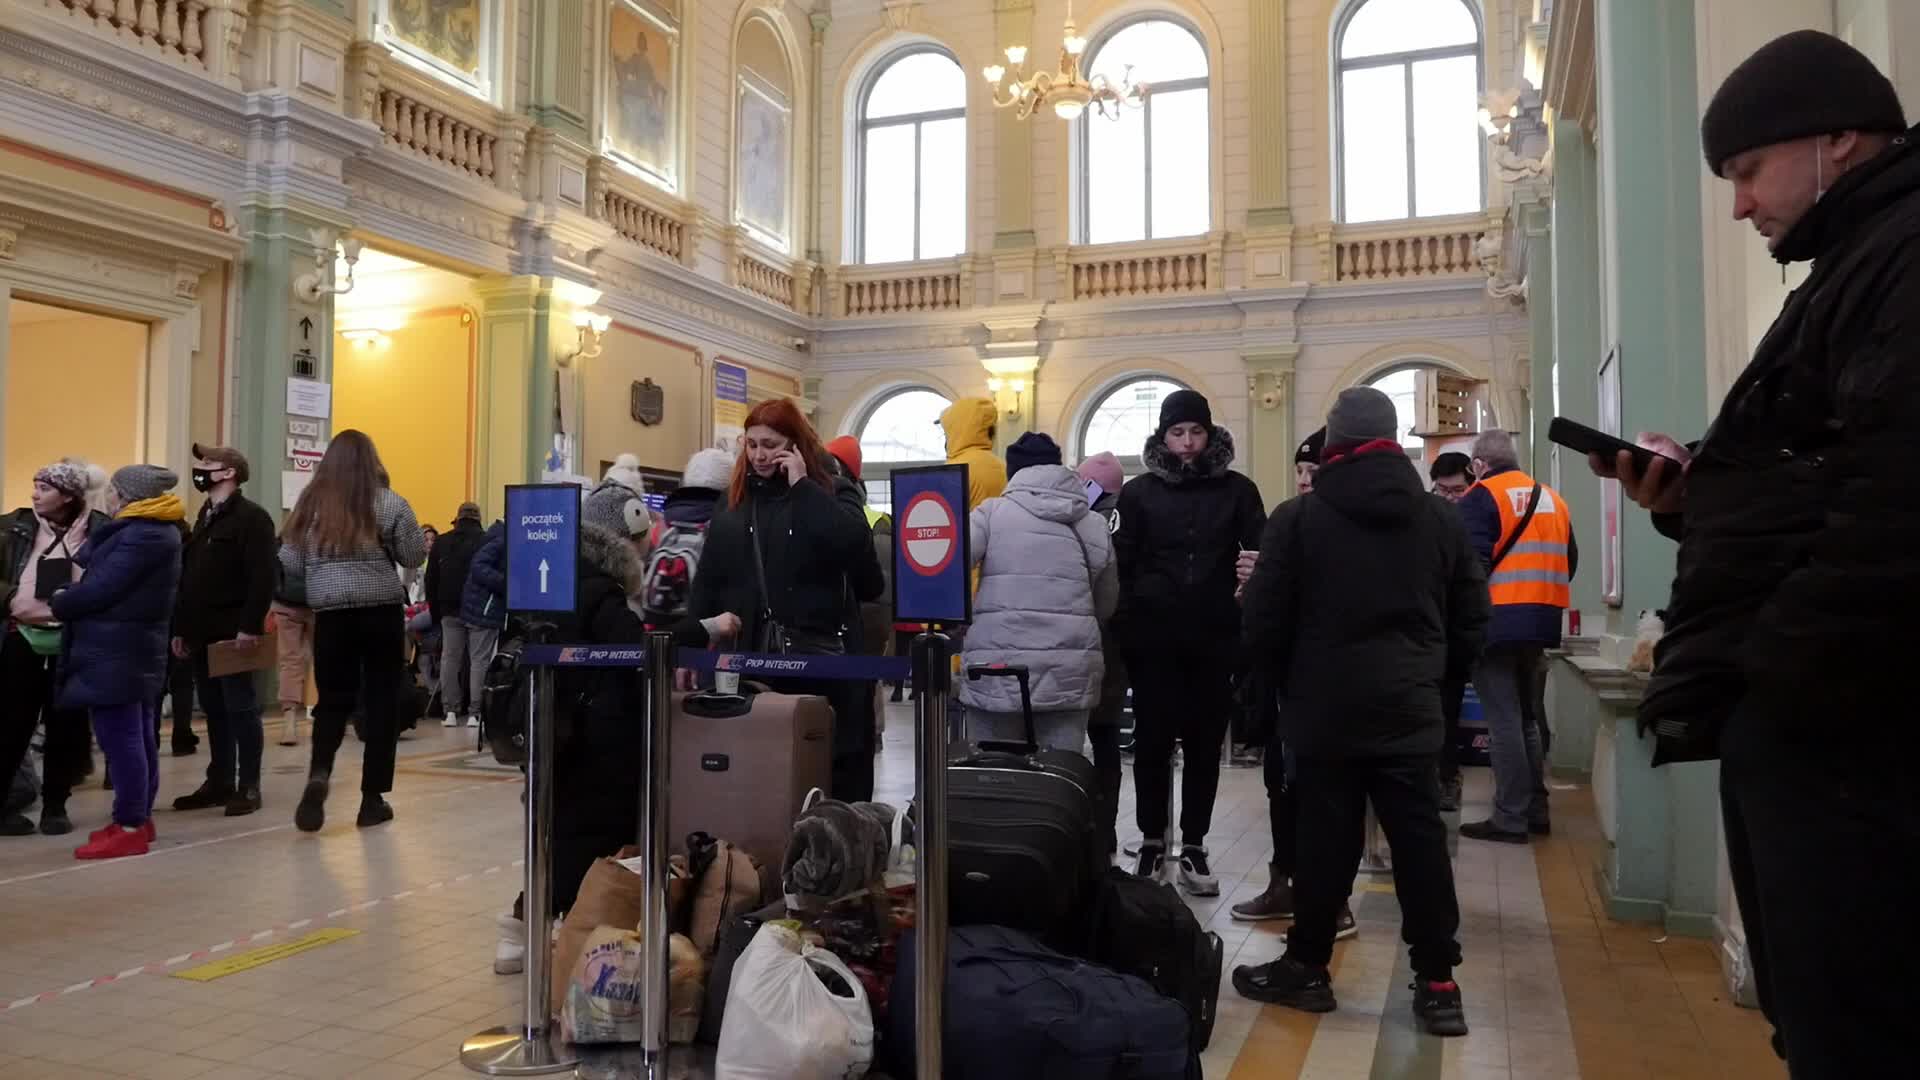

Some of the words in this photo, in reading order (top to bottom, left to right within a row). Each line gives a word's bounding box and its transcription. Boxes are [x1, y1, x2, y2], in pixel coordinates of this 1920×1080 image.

[521, 512, 564, 527] początek
[527, 529, 558, 543] kolejki
[917, 528, 940, 538] STOP!
[589, 651, 608, 660] PKP
[745, 658, 764, 668] PKP
[765, 660, 808, 670] INTERCITY
